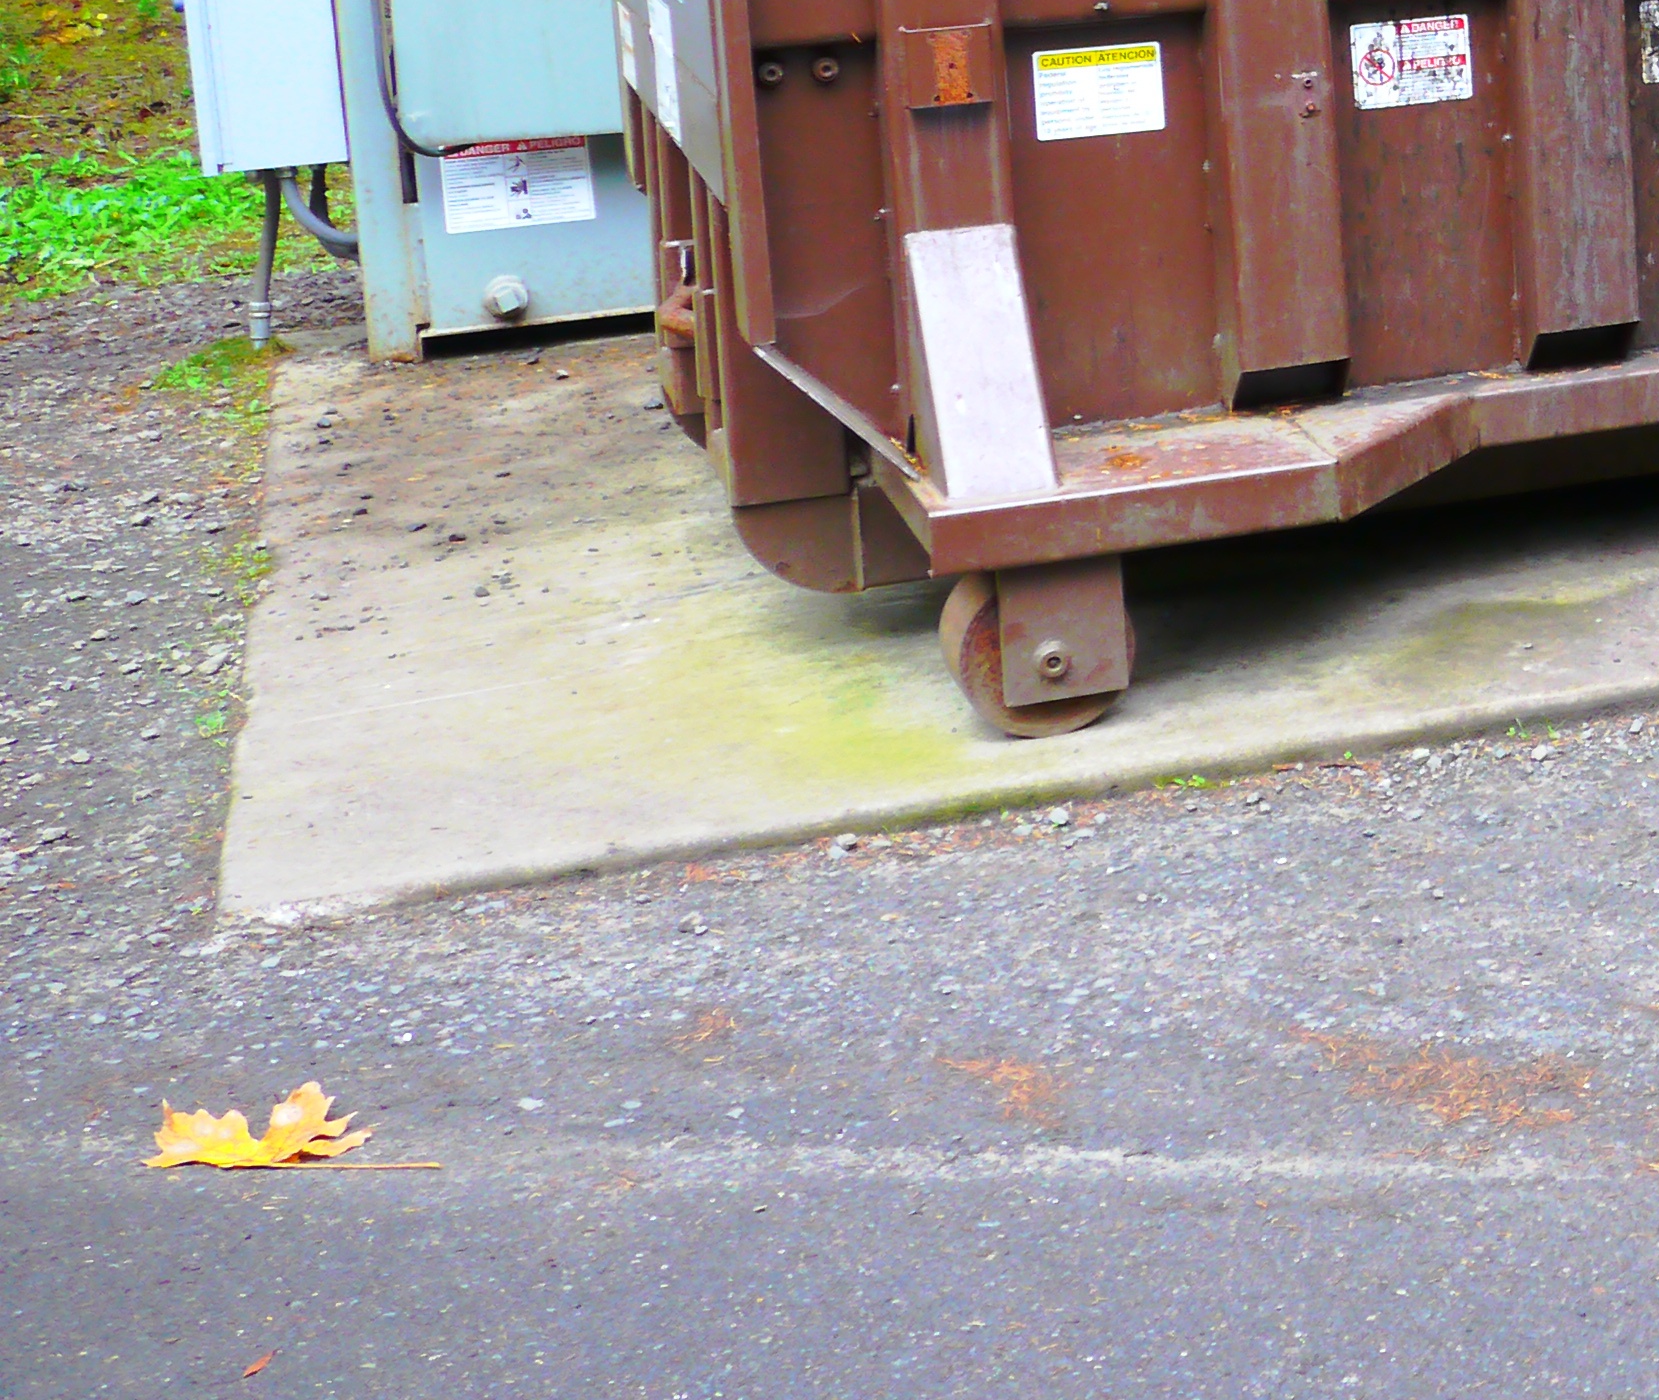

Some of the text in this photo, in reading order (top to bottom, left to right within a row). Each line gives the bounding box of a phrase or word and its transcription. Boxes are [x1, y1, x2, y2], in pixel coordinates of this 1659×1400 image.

[1040, 49, 1156, 68] CAUTION ATENCION
[529, 136, 582, 148] PELIGRO
